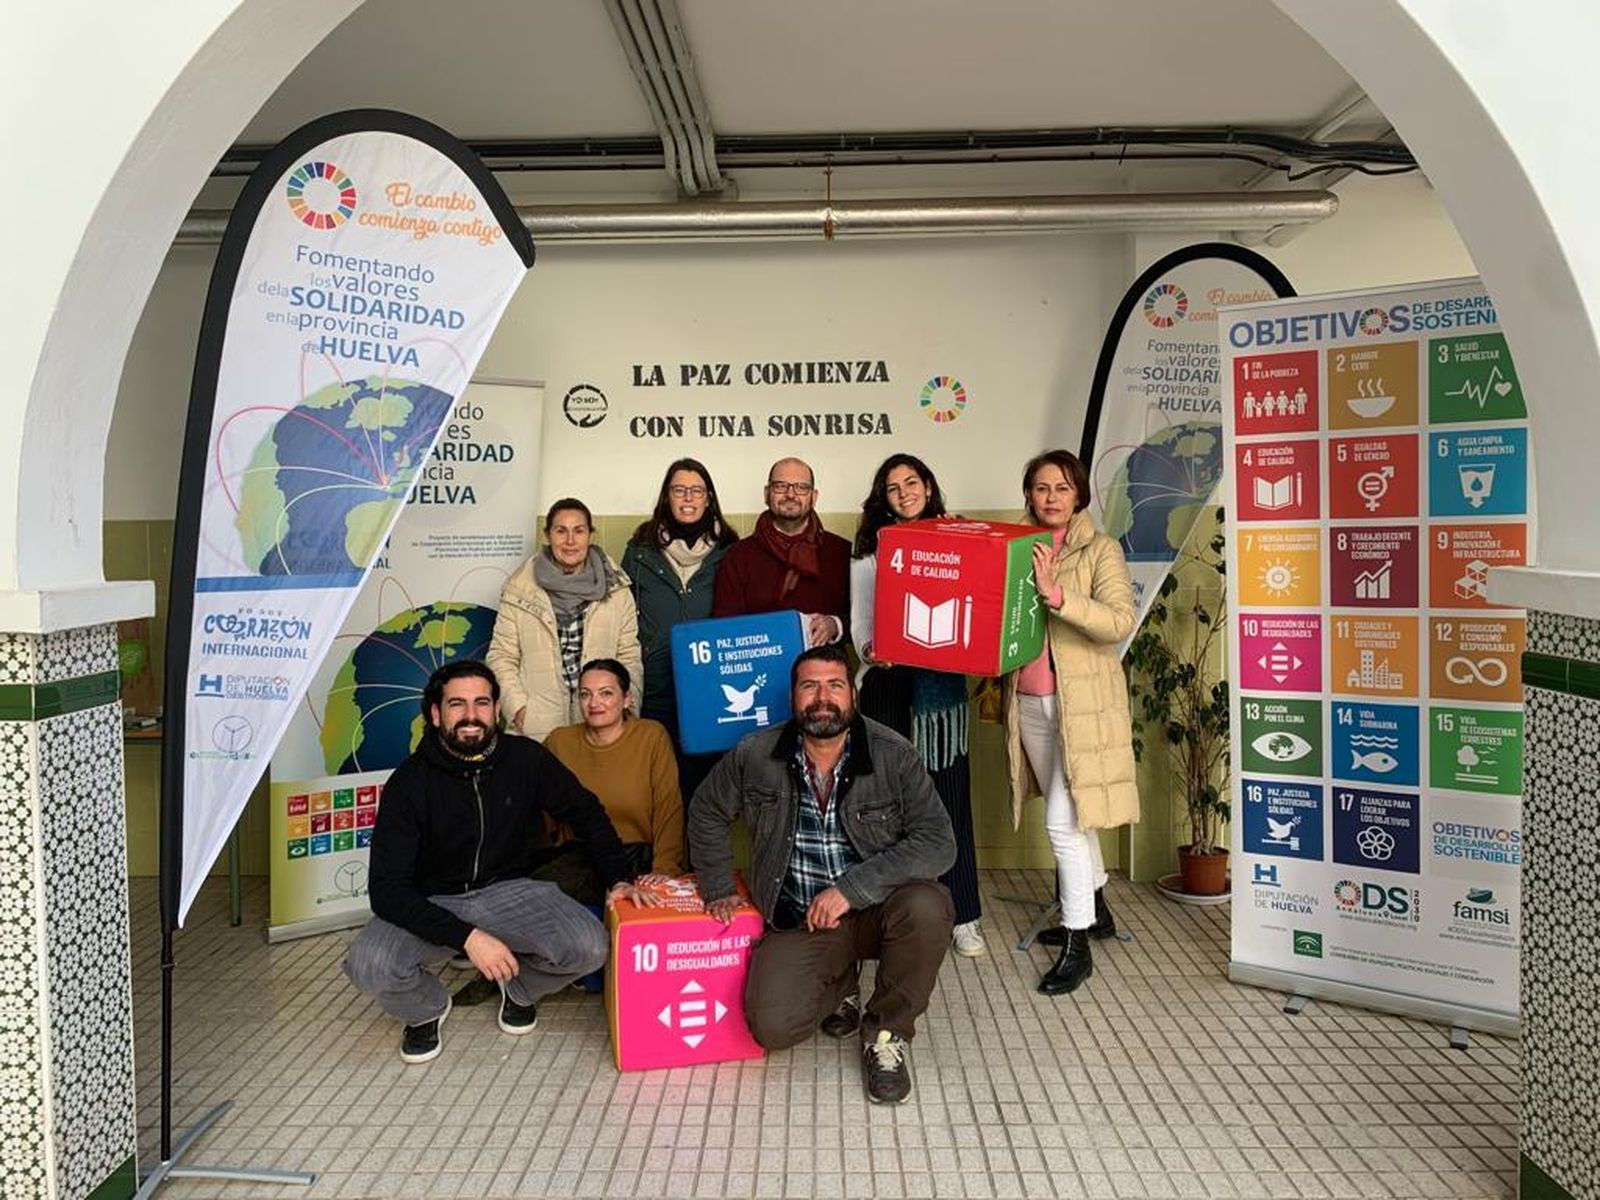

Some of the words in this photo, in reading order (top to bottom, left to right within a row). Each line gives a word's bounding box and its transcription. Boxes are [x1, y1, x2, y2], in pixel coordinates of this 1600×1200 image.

[385, 182, 413, 207] El
[416, 192, 476, 212] cambio
[358, 210, 440, 239] comienza
[443, 217, 502, 246] contigo
[296, 245, 435, 284] Fomentando
[1412, 302, 1432, 314] DE
[1229, 305, 1411, 348] OBJETIVOS
[320, 336, 419, 367] HUELVA
[1438, 344, 1449, 363] 3
[1242, 362, 1249, 380] 1
[1336, 354, 1345, 372] 2
[632, 365, 666, 386] LA
[680, 364, 731, 386] PAZ
[744, 361, 890, 385] COMIENZA
[629, 416, 684, 438] CON
[698, 415, 754, 437] UNA
[768, 413, 892, 437] SONRISA
[1337, 444, 1347, 462] 5
[1438, 439, 1449, 457] 6
[1243, 450, 1252, 466] 4
[1245, 535, 1253, 552] 7
[1337, 533, 1347, 550] 8
[1437, 531, 1448, 549] 9
[890, 548, 904, 574] 4
[912, 550, 961, 565] EDUCACIÓN
[911, 565, 922, 576] DE
[923, 566, 960, 580] CALIDAD
[1243, 619, 1258, 637] 10
[1337, 621, 1349, 638] 11
[1436, 623, 1452, 641] 12
[735, 634, 770, 646] JUSTICIA
[202, 643, 310, 660] INTERNACIONAL
[689, 641, 711, 665] 16
[718, 653, 723, 662] E
[724, 645, 783, 661] INSTITUCIONES
[1008, 641, 1018, 658] 3
[720, 662, 753, 675] SÓLIDAS
[244, 685, 289, 695] HUELVA
[1245, 703, 1260, 720] 13
[1337, 708, 1353, 725] 14
[1437, 714, 1454, 732] 15
[1247, 785, 1262, 802] 16
[1339, 793, 1354, 811] 17
[1432, 822, 1520, 843] OBJETIVOS
[1433, 835, 1448, 844] DE
[1450, 836, 1520, 852] DESARROLLO
[1433, 845, 1520, 864] SOSTENIBLE
[1254, 888, 1319, 906] DIPUTACIÓN
[1254, 900, 1269, 909] DE
[1271, 901, 1313, 915] HUELVA
[1453, 901, 1510, 925] famsi
[667, 939, 720, 954] REDUCCIÓN
[721, 937, 733, 950] DE
[735, 935, 750, 948] LAS
[631, 944, 658, 973] 10
[667, 953, 740, 971] DESIGUALDADES
